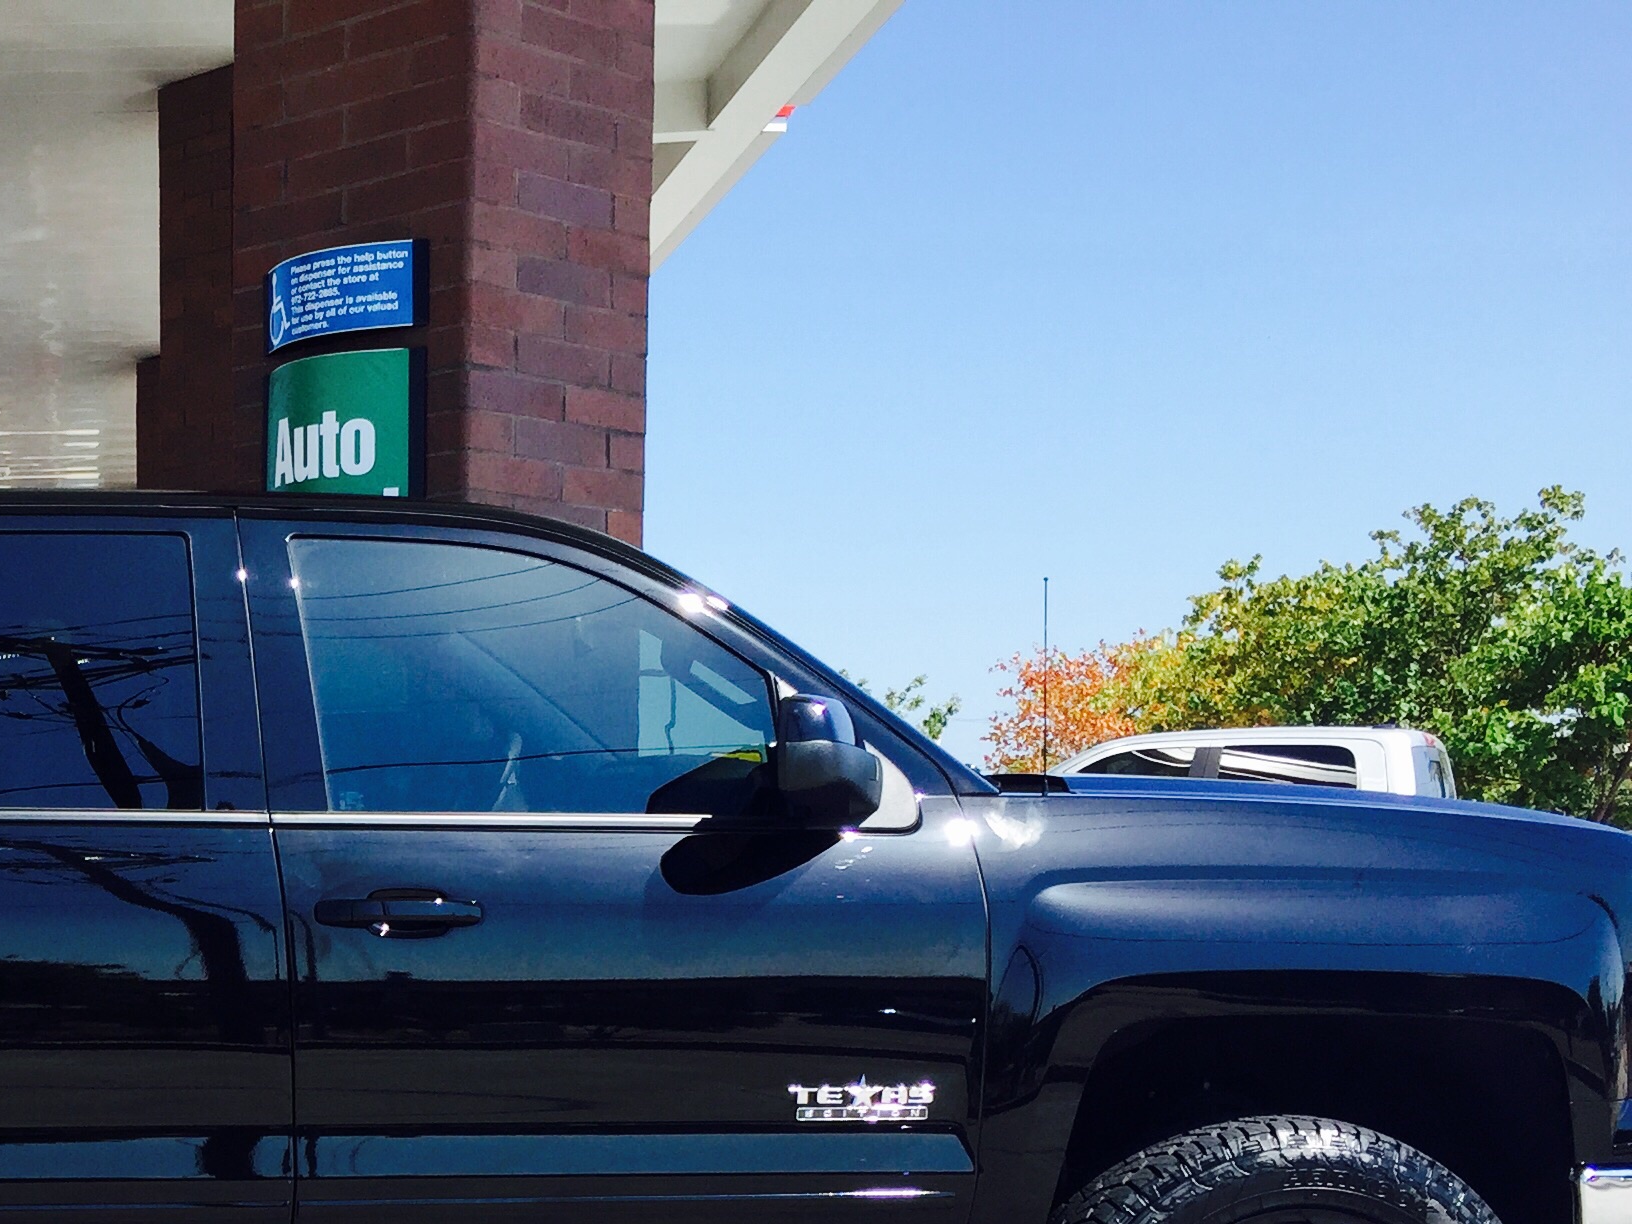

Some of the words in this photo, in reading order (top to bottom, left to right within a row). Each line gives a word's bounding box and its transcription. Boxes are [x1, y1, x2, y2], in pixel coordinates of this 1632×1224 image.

[313, 258, 335, 270] press
[337, 256, 352, 264] the
[354, 252, 374, 263] help
[377, 250, 408, 260] button
[298, 280, 325, 293] contact
[327, 278, 341, 286] the
[343, 274, 366, 284] store
[369, 272, 379, 280] at
[299, 268, 336, 284] dispenser
[338, 266, 351, 274] for
[353, 260, 404, 272] assistance
[304, 297, 344, 311] dispenser
[346, 295, 353, 304] is
[355, 290, 398, 303] available
[314, 310, 324, 320] by
[326, 308, 336, 317] all
[338, 306, 347, 315] of
[349, 304, 364, 314] our
[367, 301, 398, 312] valued
[274, 410, 376, 488] Auto
[788, 1078, 935, 1105] TEXAS
[804, 1108, 920, 1119] EDITION
